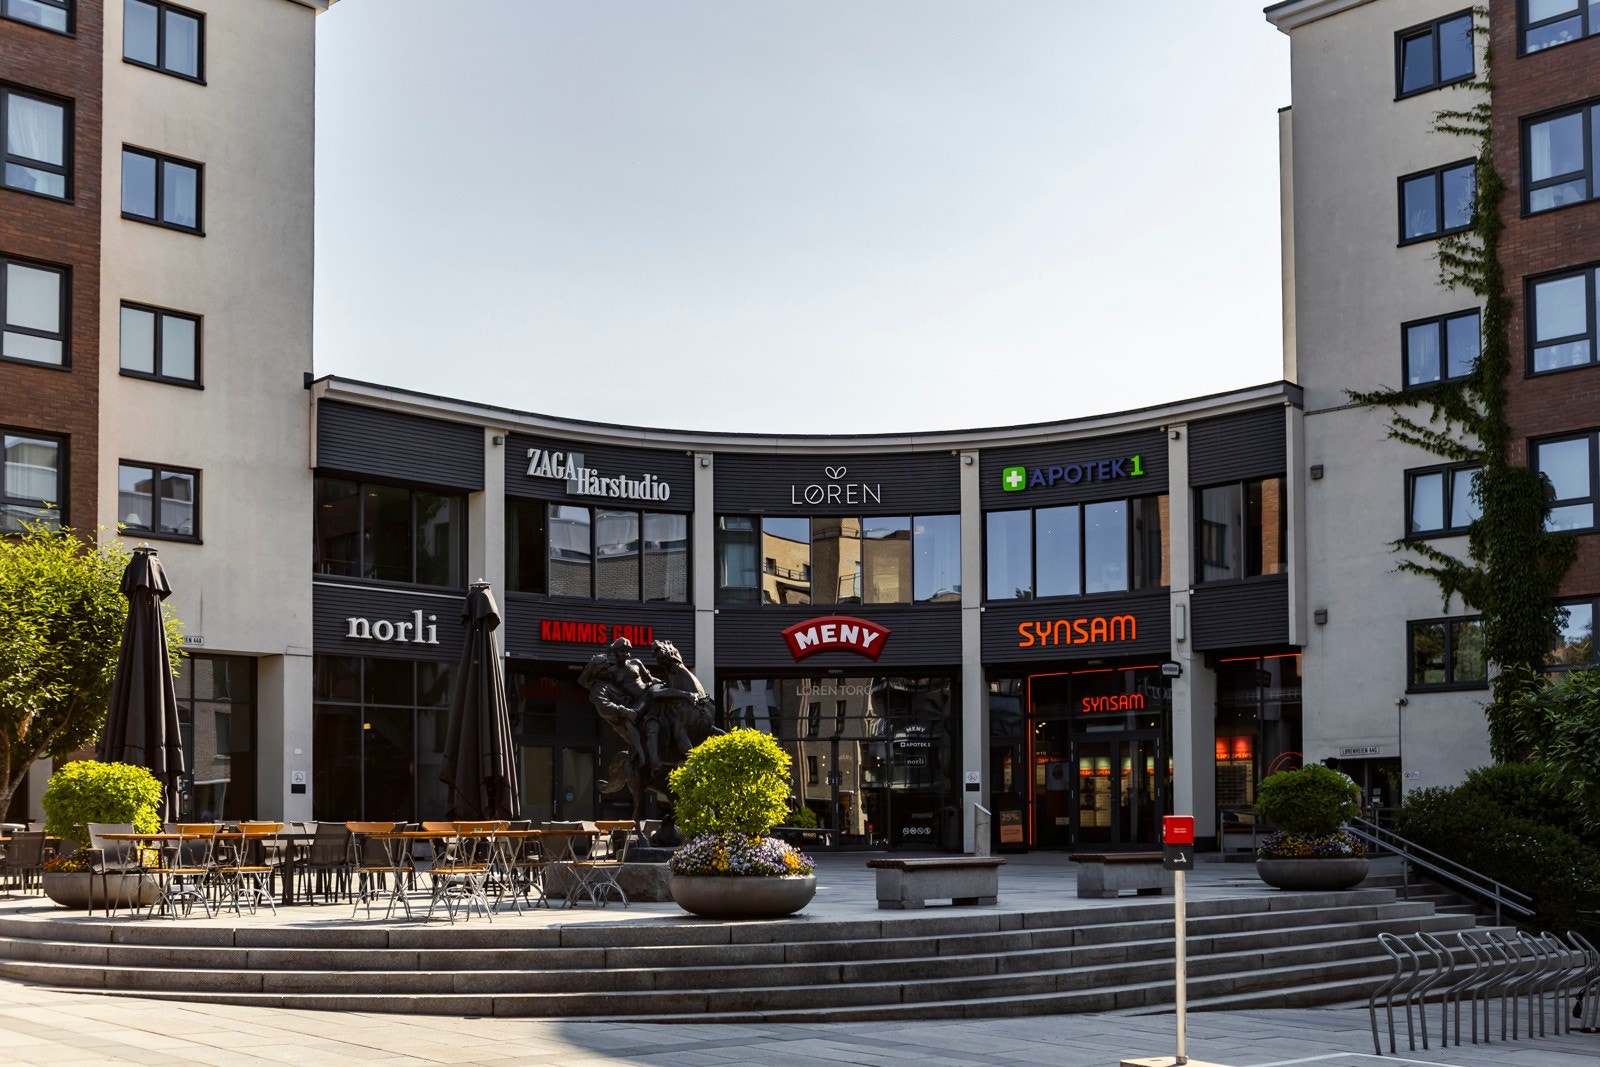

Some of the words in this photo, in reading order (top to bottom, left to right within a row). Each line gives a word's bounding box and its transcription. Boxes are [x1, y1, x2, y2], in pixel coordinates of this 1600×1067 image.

[526, 448, 577, 481] ZAGA
[1029, 458, 1127, 488] APOTEK
[576, 467, 671, 502] Hårstudio
[791, 483, 882, 506] LØREN
[345, 609, 440, 645] norli
[540, 619, 607, 645] KAMMIS
[794, 623, 880, 651] MENY
[1018, 614, 1137, 647] SYNSAM
[1082, 693, 1145, 713] SYNSAM
[907, 757, 925, 765] norli
[1001, 812, 1020, 822] 25%
